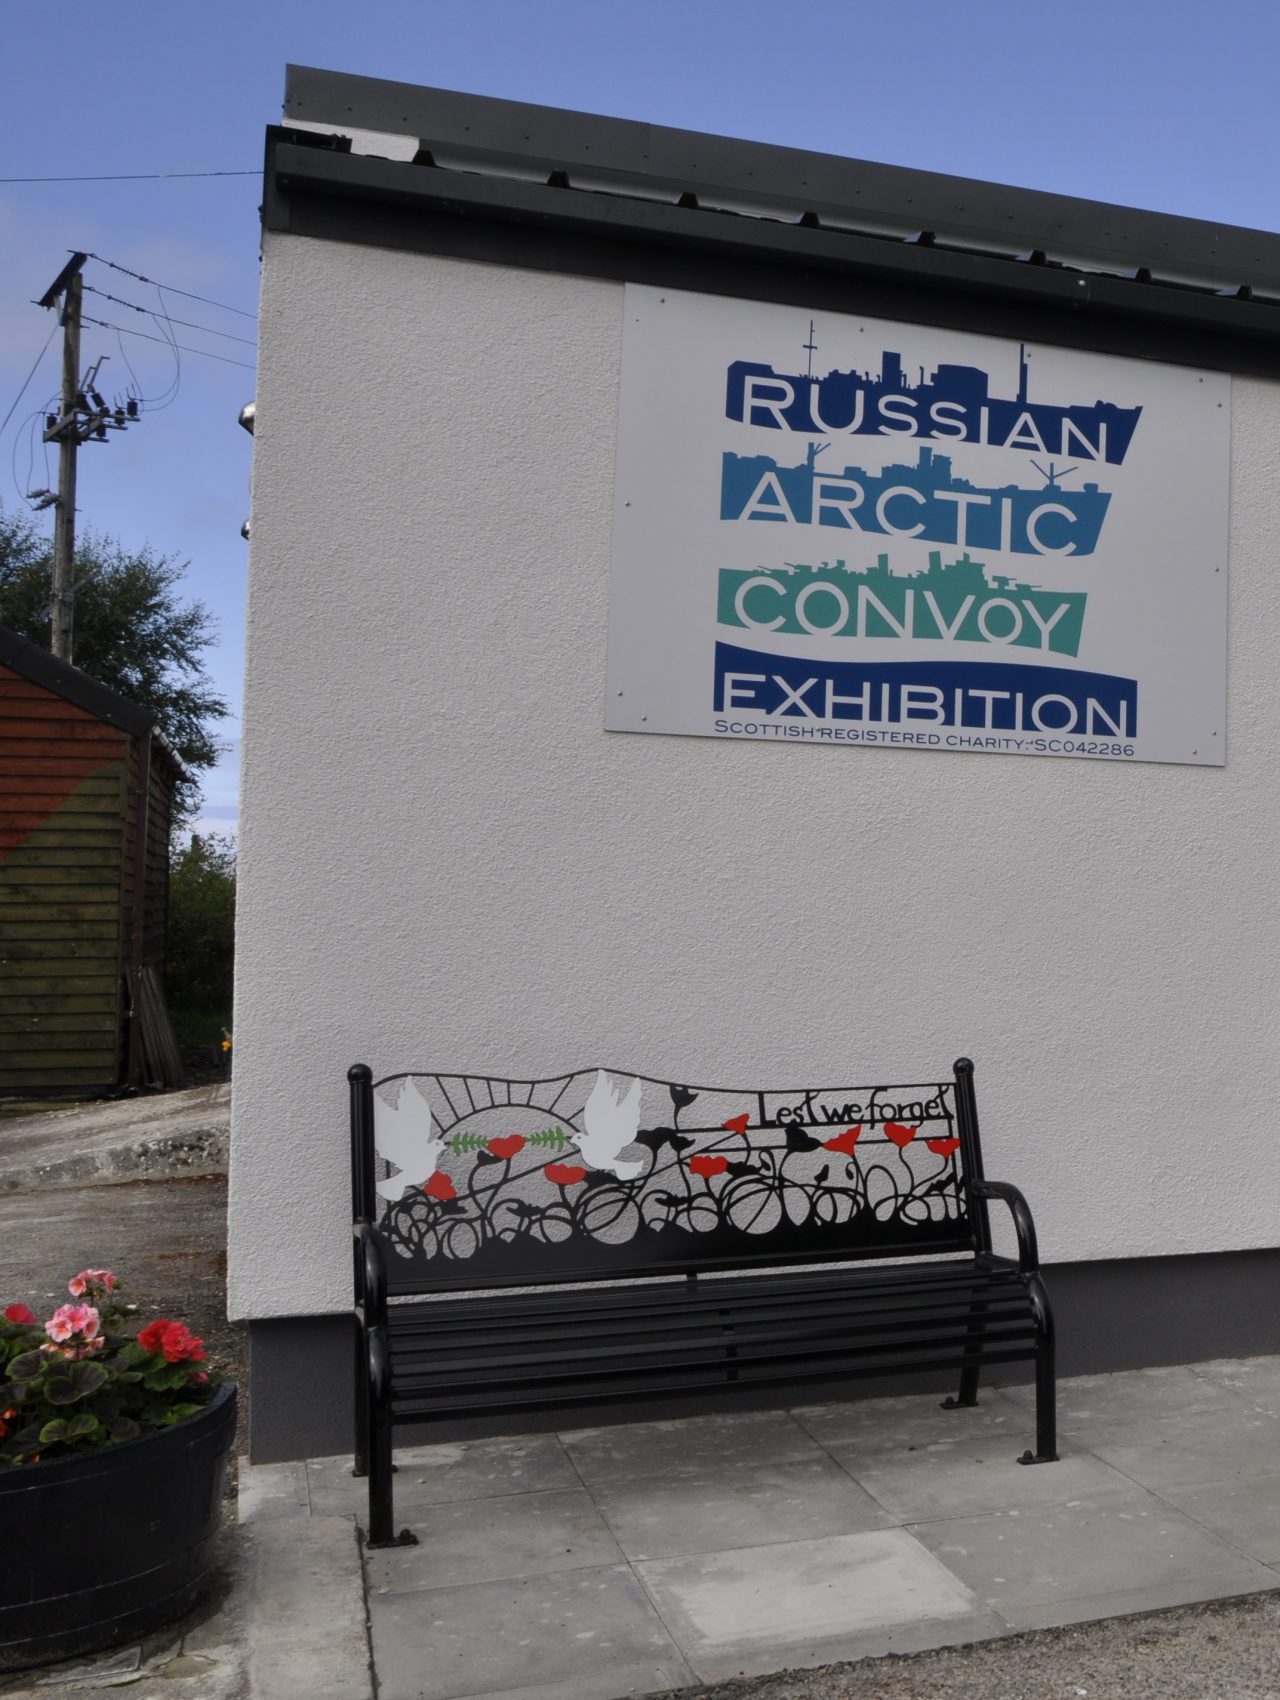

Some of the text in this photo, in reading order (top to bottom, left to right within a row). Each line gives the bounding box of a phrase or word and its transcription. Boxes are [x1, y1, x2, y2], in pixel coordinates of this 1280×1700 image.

[742, 374, 1108, 462] RUSSIAN
[737, 471, 1079, 558] ARCTIC
[734, 576, 1071, 652] CONVOY
[714, 719, 815, 738] SCOTTISH
[820, 727, 941, 746] REGISTERED
[1033, 738, 1136, 757] SC042286
[722, 671, 1128, 737] EXHIBITION
[757, 1085, 954, 1130] Lest we forget
